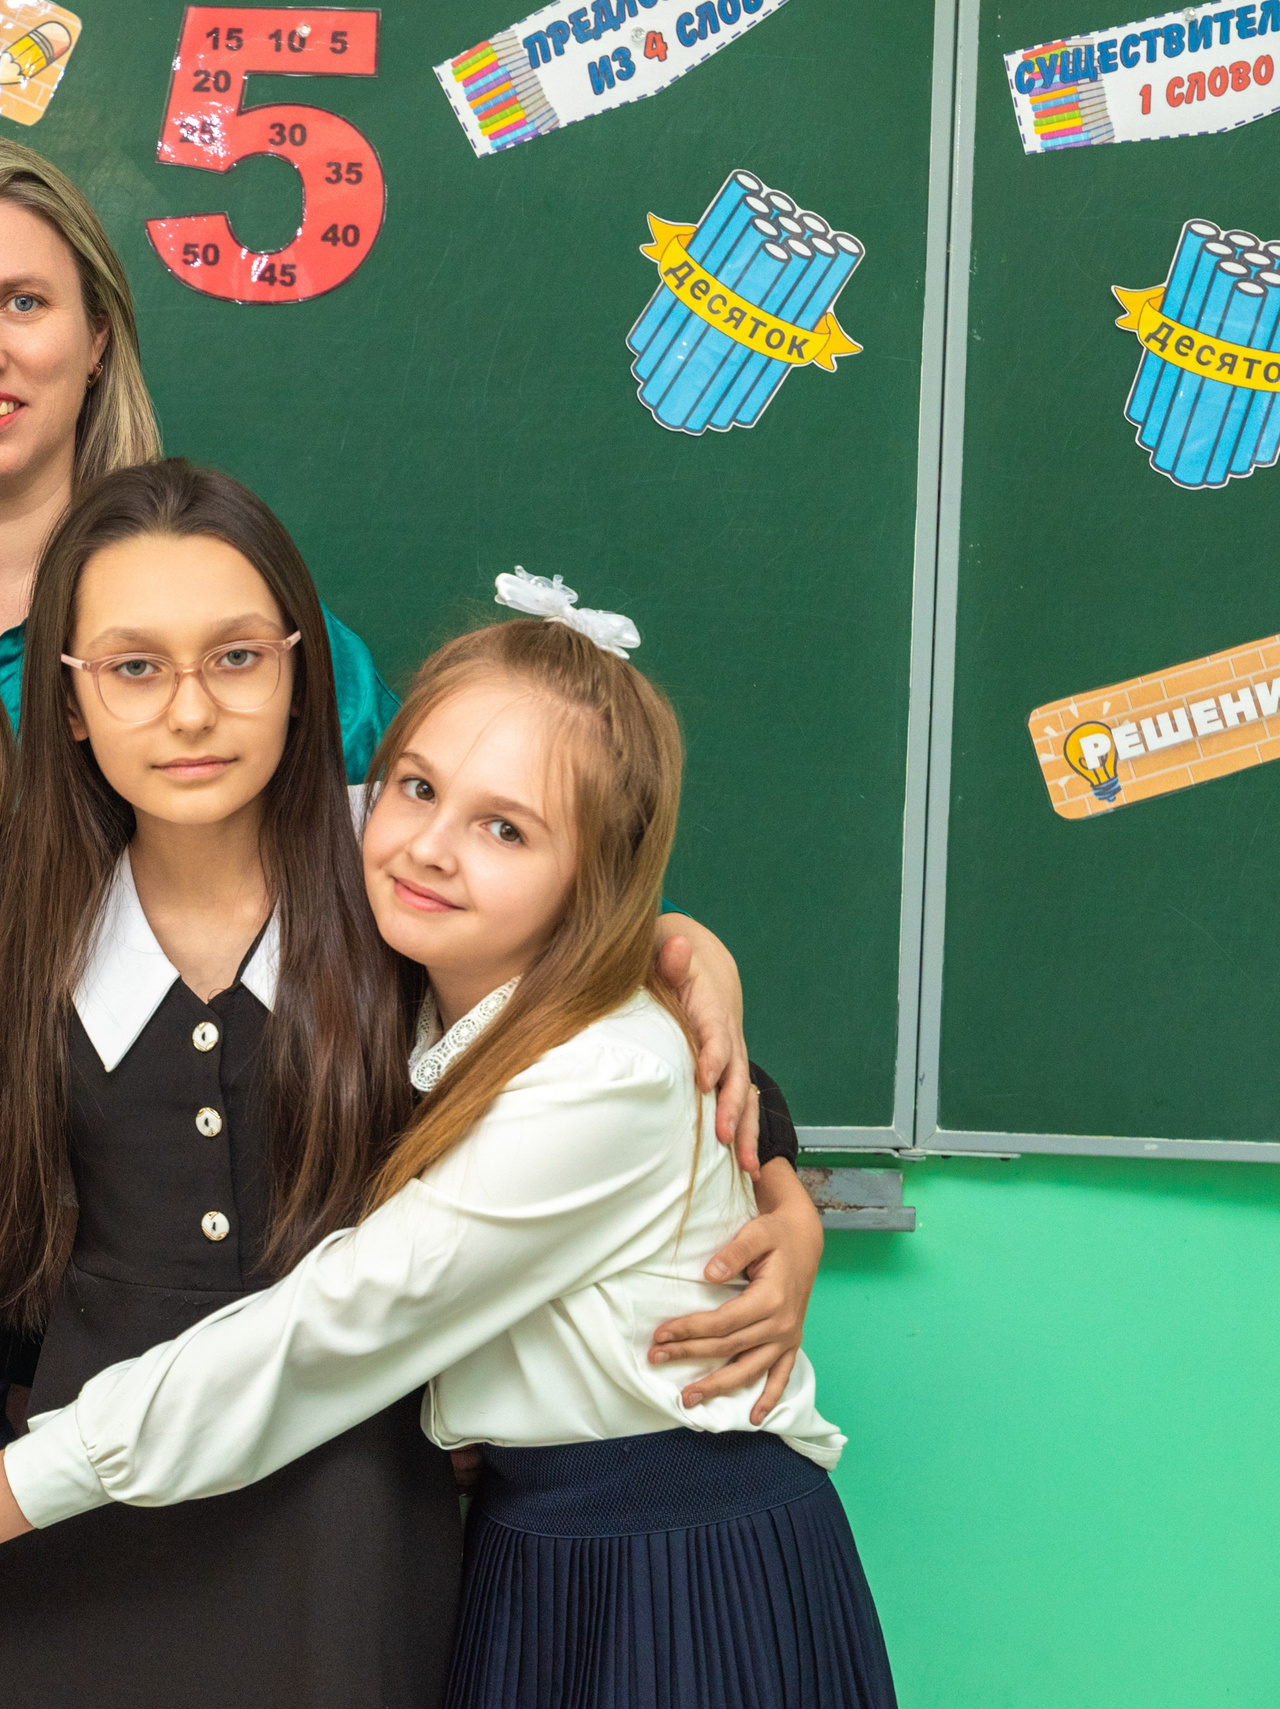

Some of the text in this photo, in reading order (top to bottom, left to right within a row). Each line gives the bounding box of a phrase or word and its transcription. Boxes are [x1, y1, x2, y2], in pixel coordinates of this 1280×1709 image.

[206, 27, 348, 54] 15 10 5
[588, 47, 636, 95] ИЗ
[644, 31, 668, 62] 4
[192, 70, 231, 93] 20
[1139, 54, 1274, 115] 1 СЛОВО
[268, 123, 307, 146] 30
[325, 162, 363, 185] 35
[321, 224, 360, 247] 40
[182, 244, 220, 266] 50
[258, 264, 297, 287] 45
[663, 260, 809, 359] десяток
